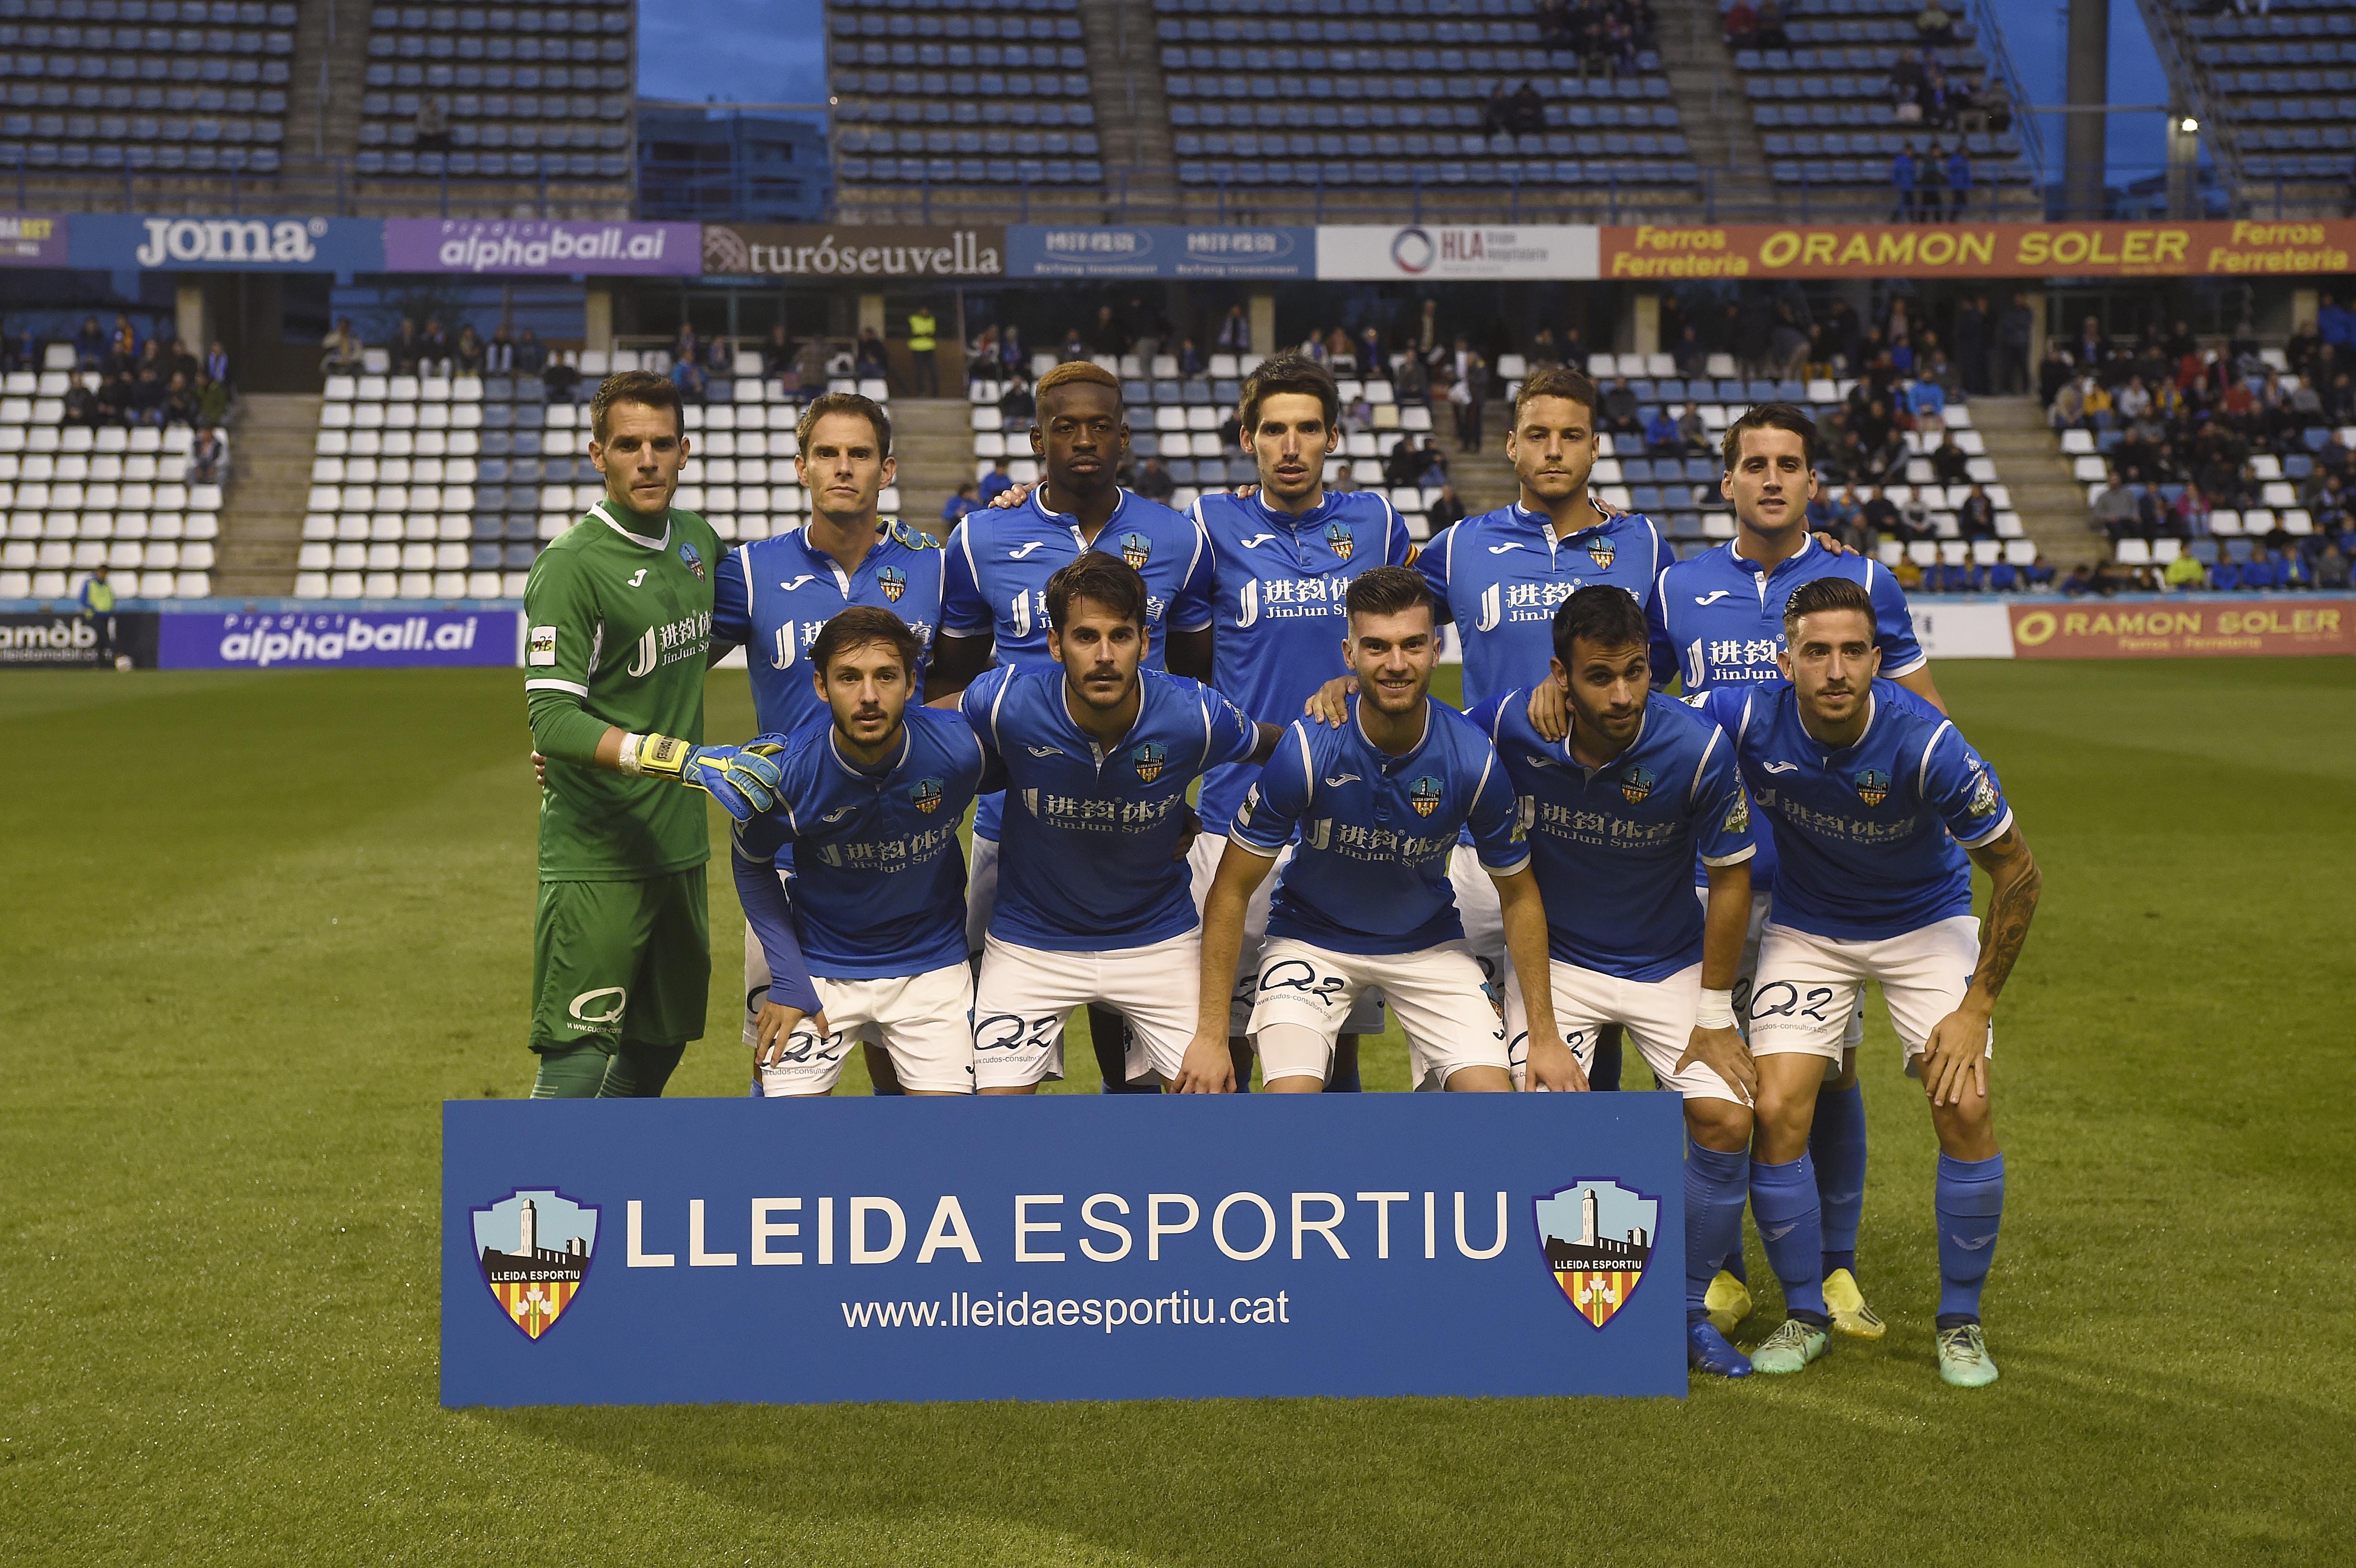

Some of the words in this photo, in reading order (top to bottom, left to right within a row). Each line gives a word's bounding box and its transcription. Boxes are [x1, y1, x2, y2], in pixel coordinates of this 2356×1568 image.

[1441, 231, 1483, 261] HLA
[1636, 226, 1726, 250] Ferros
[2230, 220, 2325, 245] Ferros
[439, 227, 666, 273] alphaball.ai
[750, 234, 1003, 274] turóseuvella
[2016, 229, 2191, 265] SOLER
[1266, 605, 1329, 619] JinJun
[2218, 609, 2341, 635] SOLER
[220, 617, 477, 666] alphaball.ai
[662, 646, 696, 666] JinJun
[1712, 667, 1778, 686] JinJun
[1046, 817, 1113, 832] JinJun
[1541, 823, 1603, 845] JinJun
[1334, 844, 1395, 862] JinJun
[1259, 960, 1345, 1006] Q2
[568, 986, 626, 1024] Q
[1750, 981, 1833, 1022] Q2
[974, 1014, 1058, 1051] Q2
[626, 1195, 983, 1268] LLEIDA
[1014, 1191, 1508, 1263] ESPORTIU
[491, 1271, 527, 1281] LLEIDA
[530, 1270, 580, 1280] ESPORTIU
[1555, 1260, 1590, 1269] LLEIDA
[1592, 1260, 1642, 1269] ESPORTIU
[841, 1289, 1290, 1334] www.lleidaesportiu.cat
